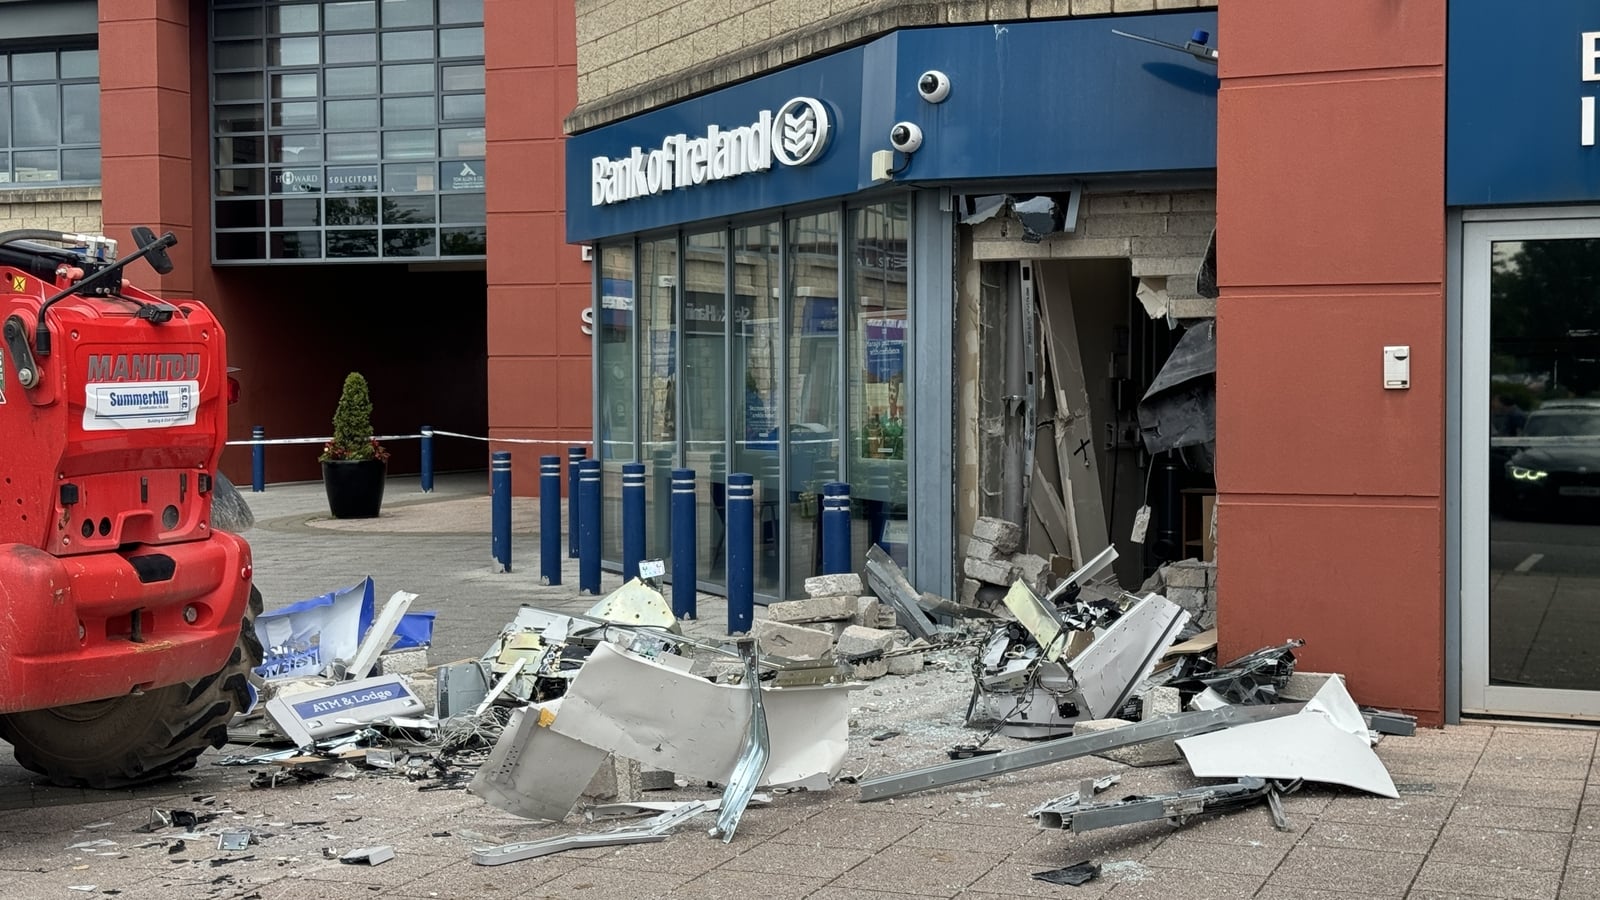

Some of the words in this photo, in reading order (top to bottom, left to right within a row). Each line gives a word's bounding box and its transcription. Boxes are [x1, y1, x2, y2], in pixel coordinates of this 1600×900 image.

[329, 175, 377, 184] SOLICITORS
[88, 354, 200, 381] MANITOU
[109, 390, 169, 407] Summerhill
[312, 699, 342, 713] ATM
[341, 696, 352, 706] &
[351, 690, 393, 704] Lodge
